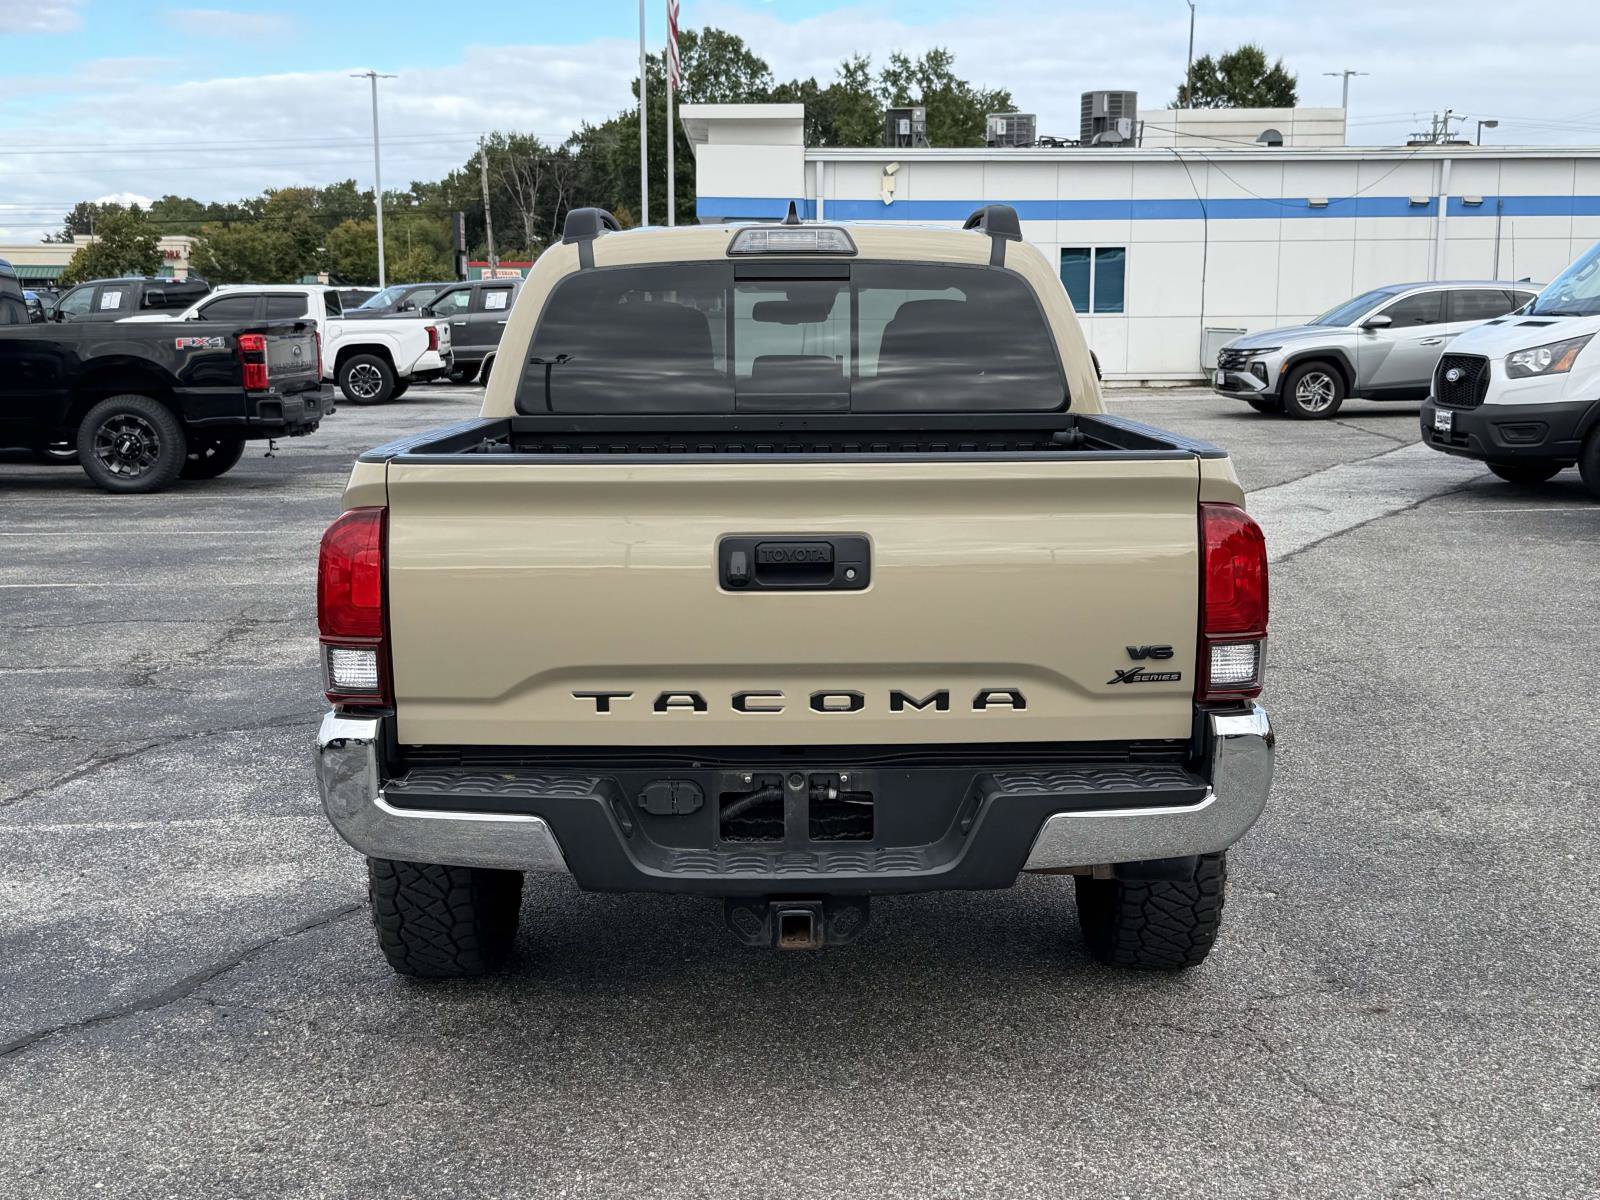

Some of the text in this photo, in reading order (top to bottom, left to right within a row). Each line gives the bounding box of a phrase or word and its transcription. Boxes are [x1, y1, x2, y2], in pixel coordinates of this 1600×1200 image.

[175, 336, 225, 350] FX4
[761, 548, 828, 562] TOYOTA
[1126, 645, 1174, 660] V6
[571, 687, 1028, 715] TACOMA
